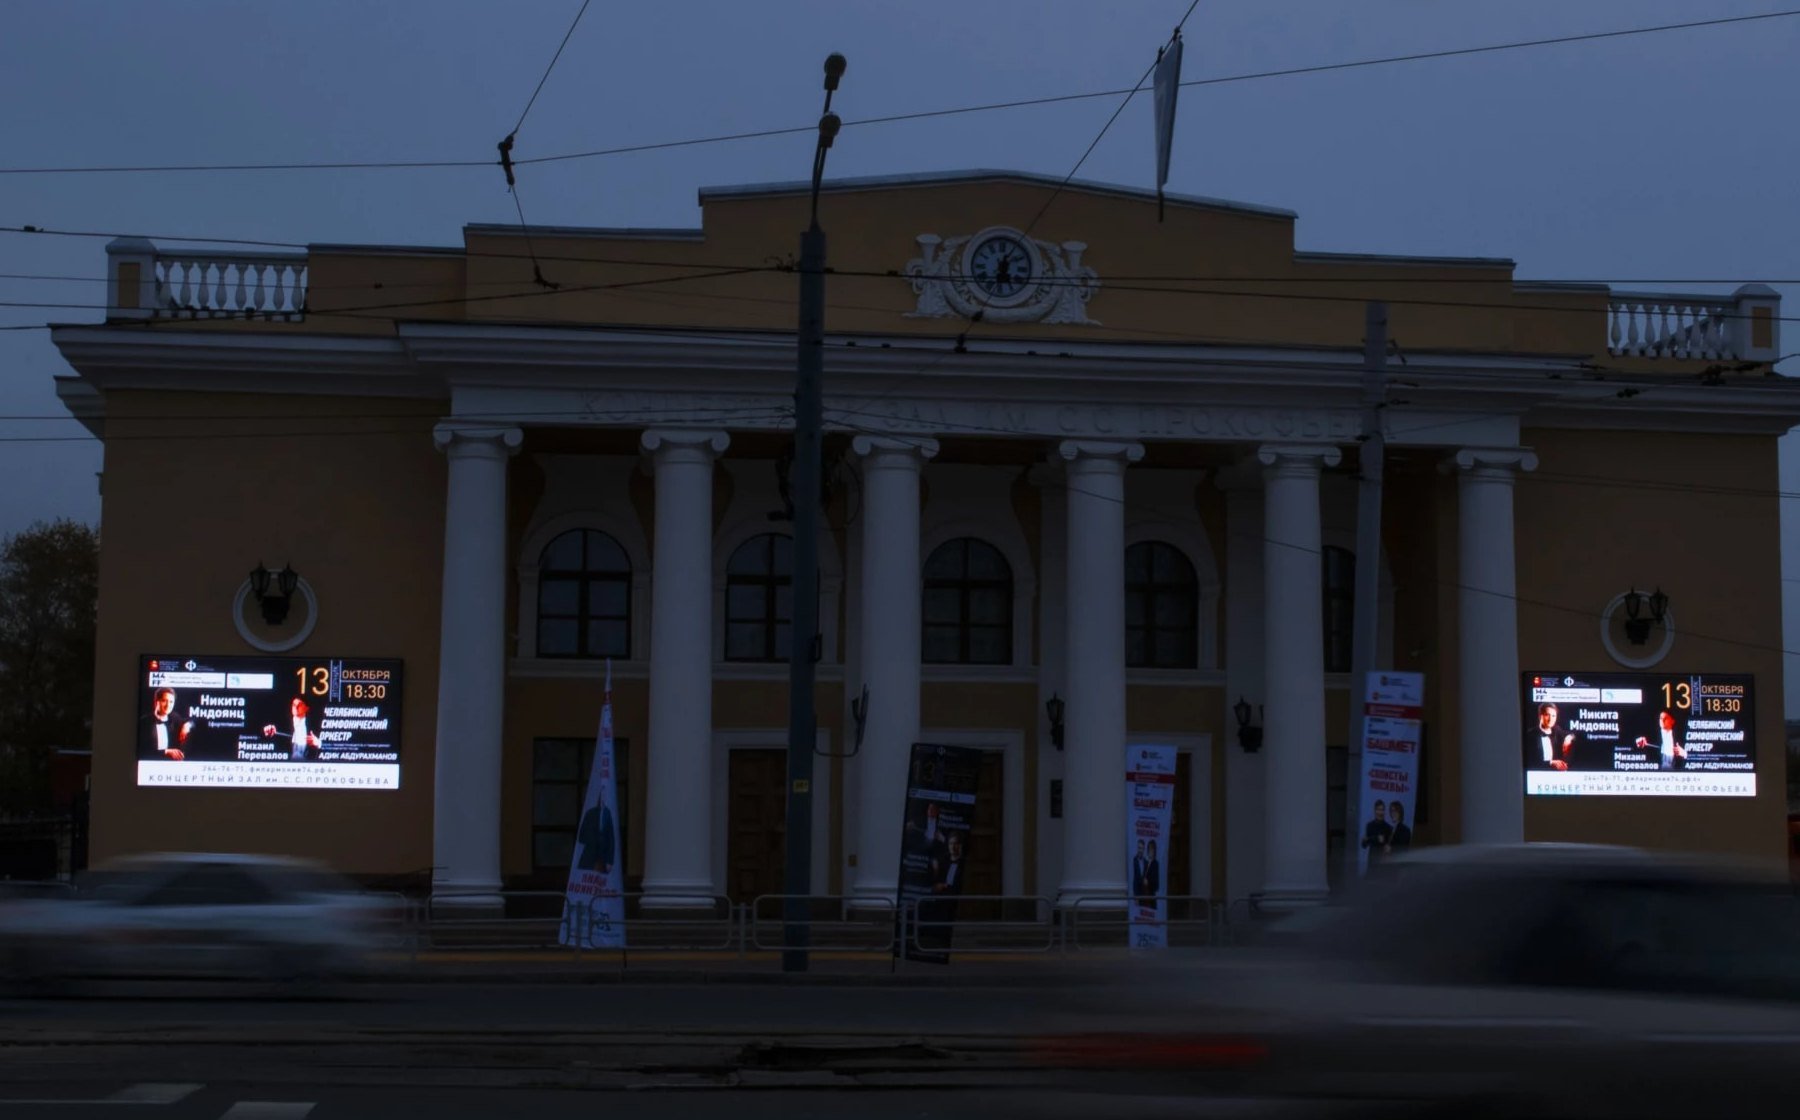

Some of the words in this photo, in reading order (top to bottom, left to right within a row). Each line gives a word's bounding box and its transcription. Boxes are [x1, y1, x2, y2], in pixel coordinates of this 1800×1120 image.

[342, 670, 390, 680] ОКТЯБРЯ
[297, 667, 329, 695] 13
[346, 684, 386, 699] 18:30
[1701, 685, 1744, 695] ОКТЯБРЯ
[200, 694, 245, 706] Никита
[1662, 682, 1690, 709] 13
[1706, 699, 1740, 712] 18:30
[324, 706, 378, 718] ЧЕЛЯБИНСКИЙ
[1579, 709, 1619, 720] Никита
[321, 718, 388, 730] СИМФОНИЧЕСКИЙ
[1687, 719, 1735, 730] ЧЕЛЯБИНСКИЙ
[319, 731, 352, 742] ОРКЕСТР
[1686, 731, 1744, 742] СИМФОНИЧЕСКИЙ
[238, 741, 274, 750] Михаил
[1684, 743, 1713, 752] ОРКЕСТР
[238, 750, 289, 761] Перевалов
[318, 752, 339, 760] АДИК
[340, 752, 398, 761] АБДУРАХМАНОВ
[1614, 752, 1646, 761] Михаил
[1614, 762, 1659, 771] Перевалов
[1684, 762, 1703, 770] АДИК
[1704, 762, 1754, 770] АБДУРАХМАНОВ
[148, 774, 234, 783] КОНЦЕРТНЫЙ
[1537, 784, 1612, 792] КОНЦЕРТНЫЙ
